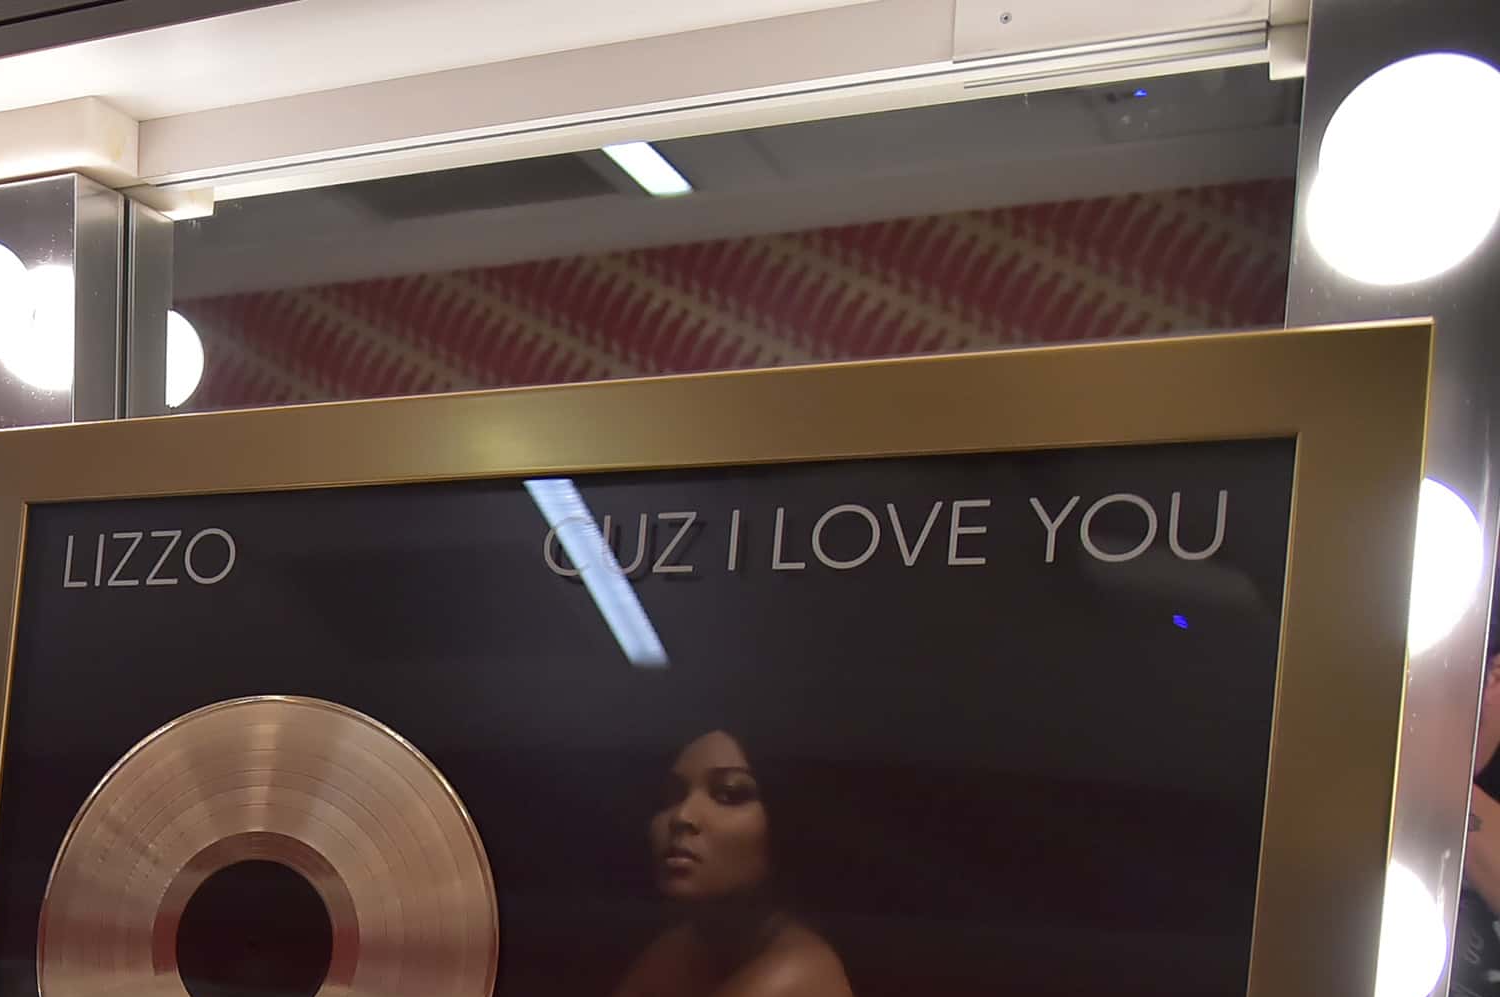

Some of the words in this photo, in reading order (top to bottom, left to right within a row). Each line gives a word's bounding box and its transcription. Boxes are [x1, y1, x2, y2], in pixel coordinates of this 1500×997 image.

[63, 527, 237, 590] LIZZO
[727, 509, 741, 571] I
[772, 498, 991, 570] LOVE
[1030, 490, 1227, 563] YOU
